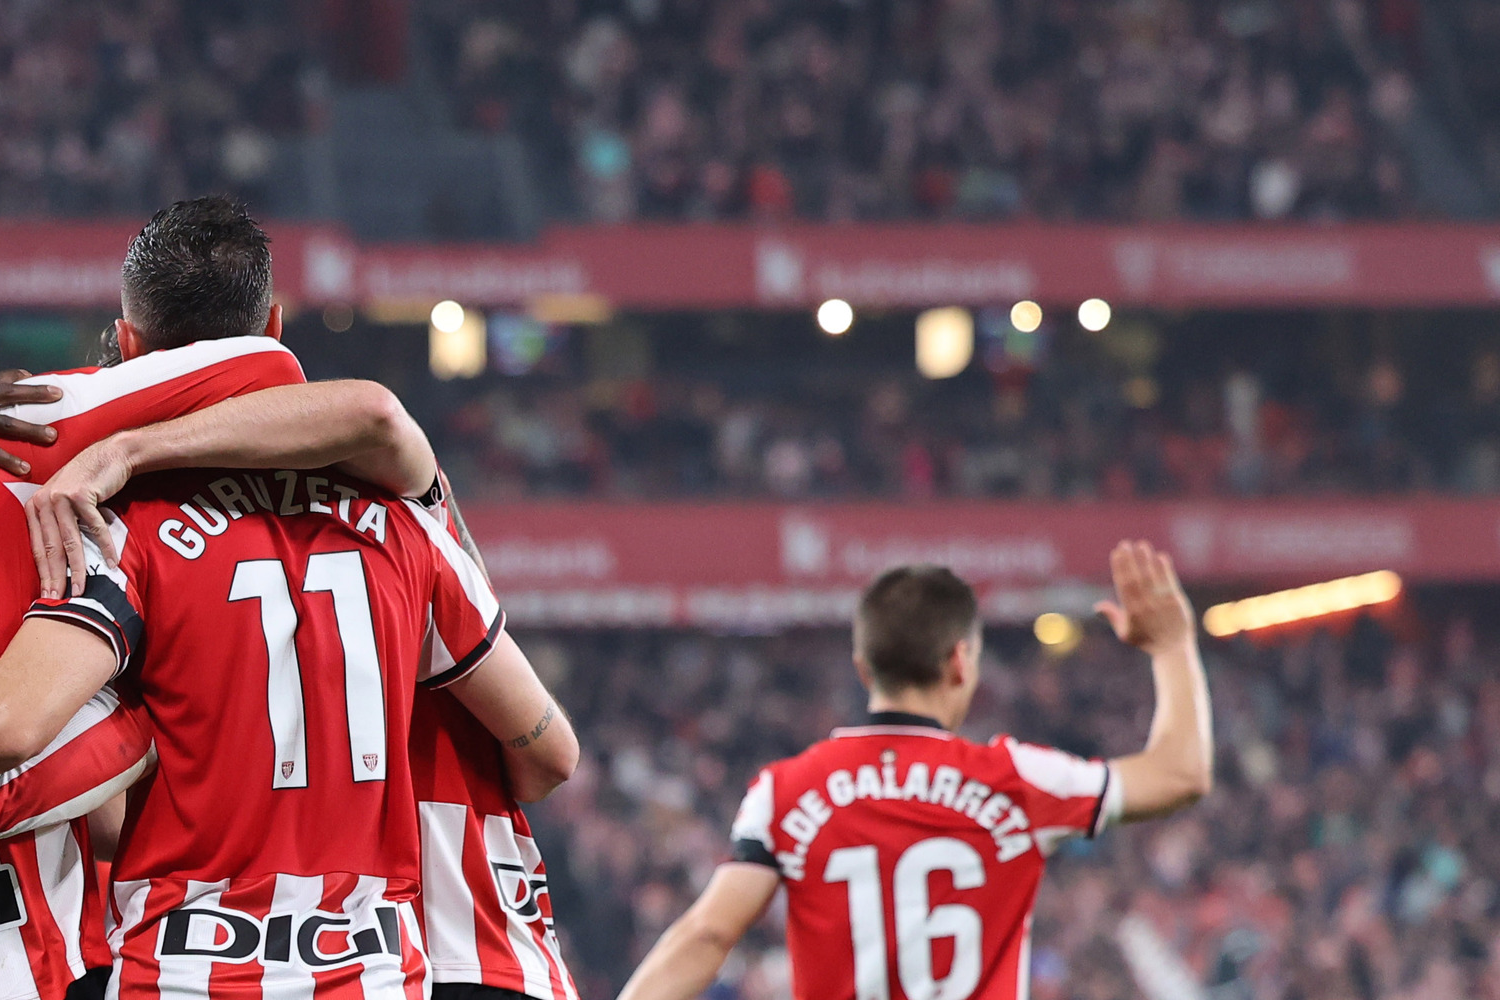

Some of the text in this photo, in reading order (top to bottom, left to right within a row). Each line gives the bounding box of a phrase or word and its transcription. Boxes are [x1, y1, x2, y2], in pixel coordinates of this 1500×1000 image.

[157, 469, 388, 561] GURUZETA
[226, 549, 387, 790] 11
[159, 905, 403, 969] DIGI
